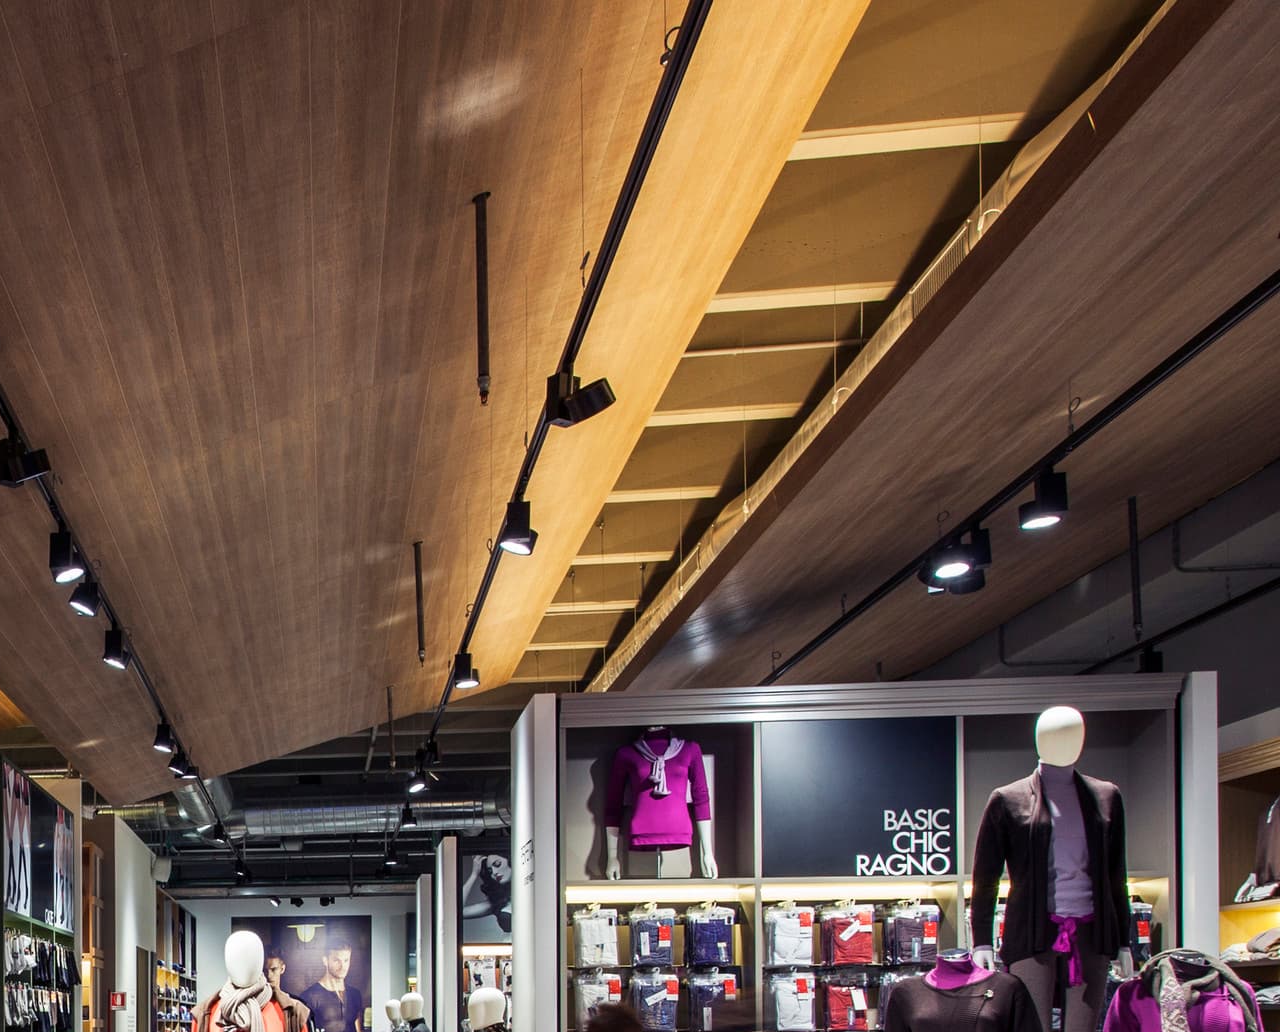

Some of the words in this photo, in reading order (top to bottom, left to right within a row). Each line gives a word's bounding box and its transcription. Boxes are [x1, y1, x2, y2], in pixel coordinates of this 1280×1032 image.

[883, 808, 950, 831] BASIC
[892, 831, 951, 853] CHIC
[856, 853, 951, 876] RAGNO
